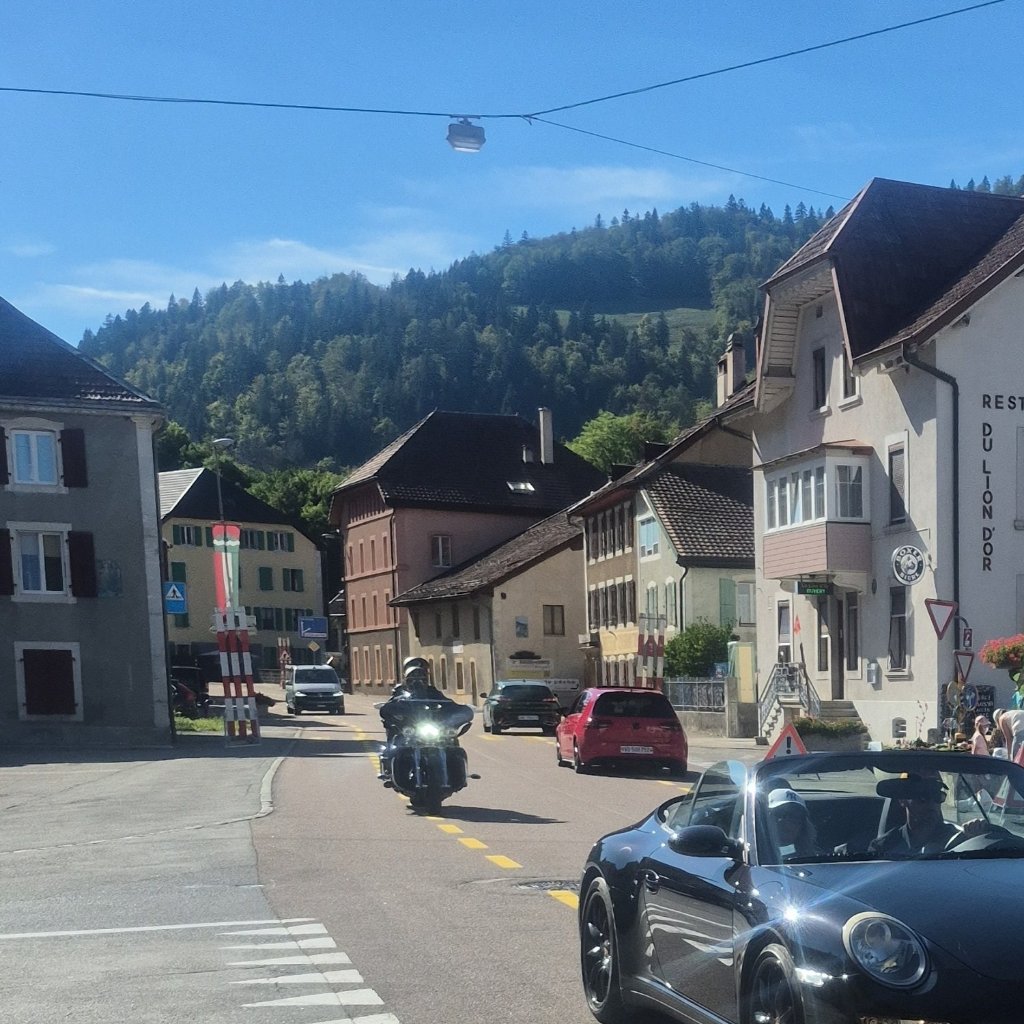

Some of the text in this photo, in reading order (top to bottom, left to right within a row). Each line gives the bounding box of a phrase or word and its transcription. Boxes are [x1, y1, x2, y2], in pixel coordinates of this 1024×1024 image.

[982, 422, 995, 571] DU LION D'OR
